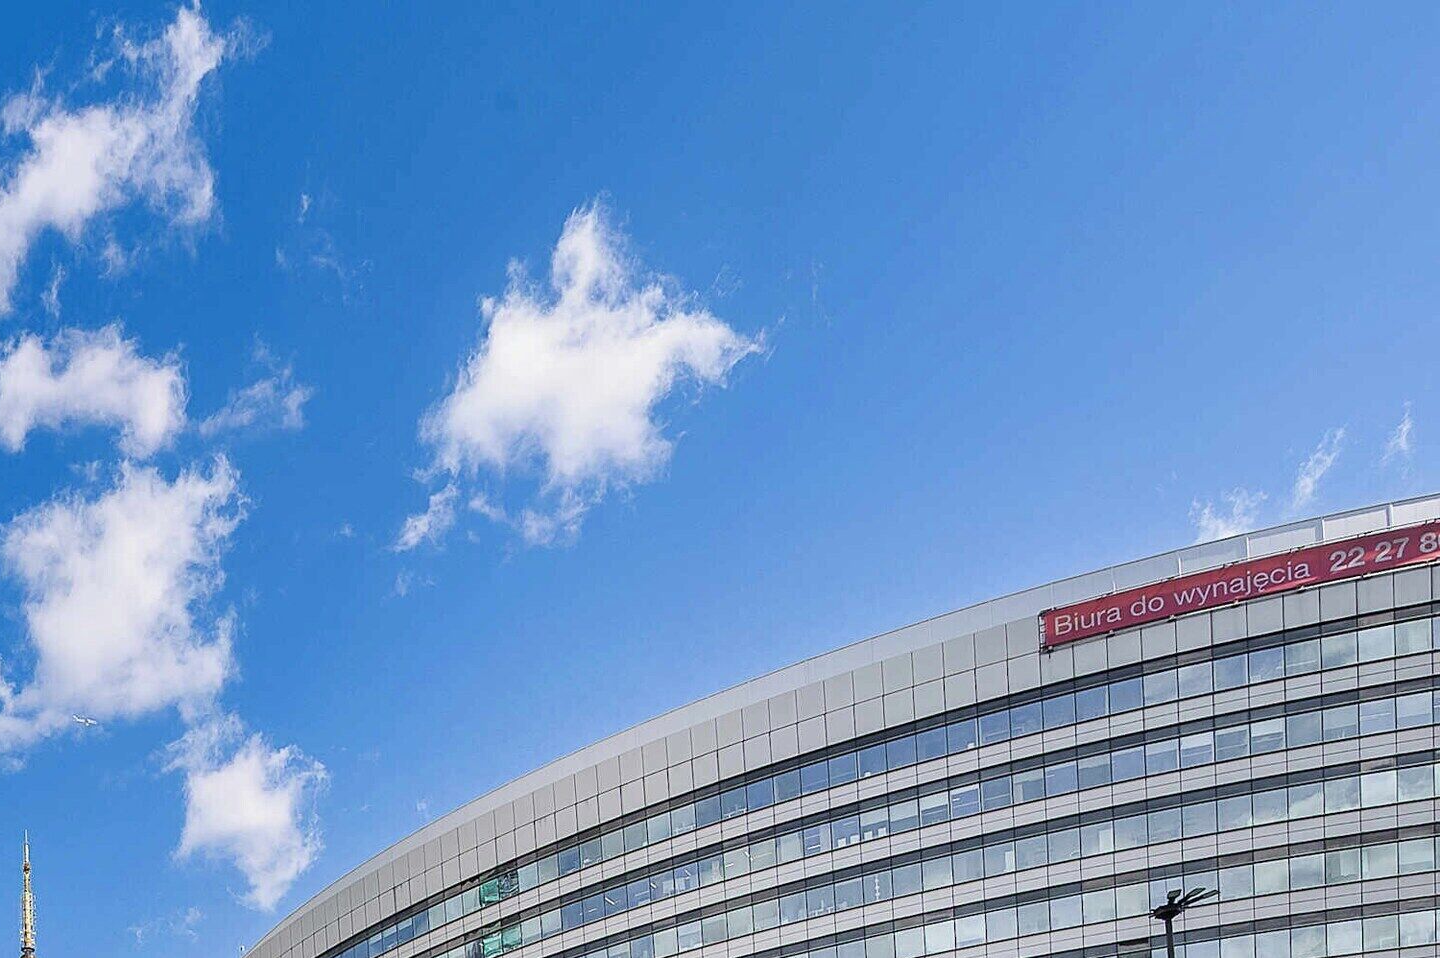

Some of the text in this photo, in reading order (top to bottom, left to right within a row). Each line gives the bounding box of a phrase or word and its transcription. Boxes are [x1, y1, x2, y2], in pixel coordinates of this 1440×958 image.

[1054, 531, 1440, 636] Biura do wynajęcia 22 27 8
